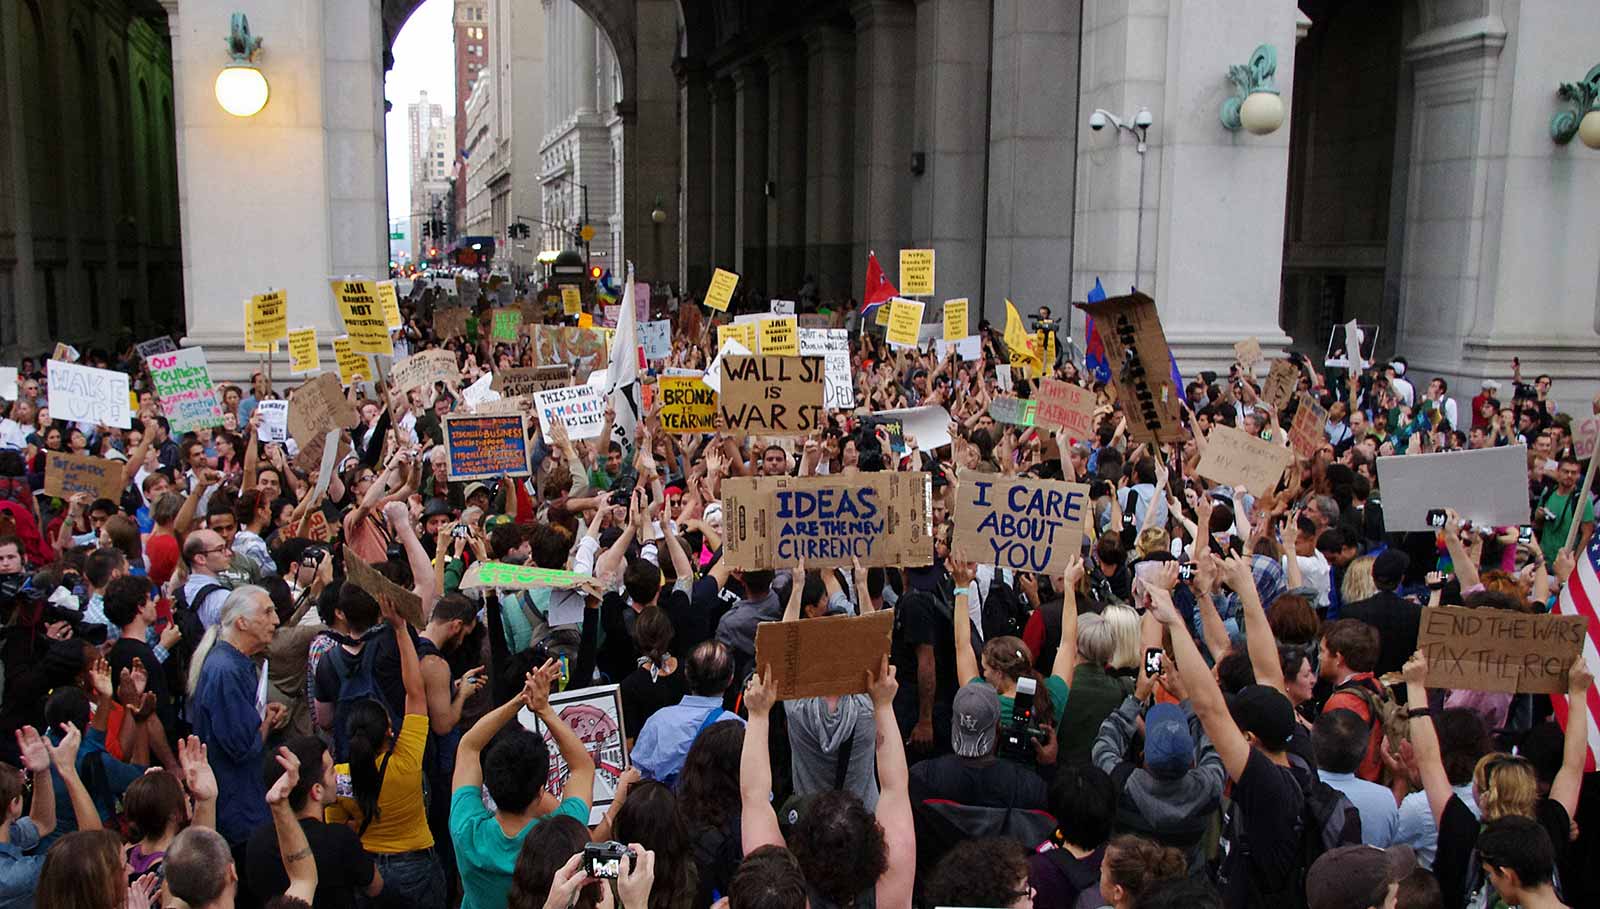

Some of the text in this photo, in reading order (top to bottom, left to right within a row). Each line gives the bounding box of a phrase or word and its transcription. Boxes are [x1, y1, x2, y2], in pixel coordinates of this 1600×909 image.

[343, 283, 367, 293] JAIL
[261, 293, 278, 302] JAIL
[342, 295, 374, 303] BANKERS
[262, 308, 279, 316] NOT
[350, 304, 372, 315] NOT
[768, 319, 787, 328] JAIL
[770, 335, 788, 343] NOT
[721, 356, 824, 384] WALL ST.
[674, 380, 694, 388] THE
[764, 386, 783, 400] IS
[540, 386, 595, 404] THIS IS WHAT
[663, 388, 717, 406] BRONX
[543, 400, 599, 419] DEMOCRACY
[720, 403, 788, 431] WAR
[776, 487, 879, 519] IDEAS
[972, 481, 1085, 522] I CARE
[780, 521, 819, 537] ARE
[819, 520, 849, 537] THE
[849, 519, 885, 536] NEW
[976, 510, 1064, 545] ABOUT
[777, 536, 876, 561] CURRENCY
[989, 537, 1052, 573] YOU
[1426, 611, 1583, 647] END THE WARS
[1422, 642, 1468, 677] TAX
[1470, 649, 1514, 680] THE
